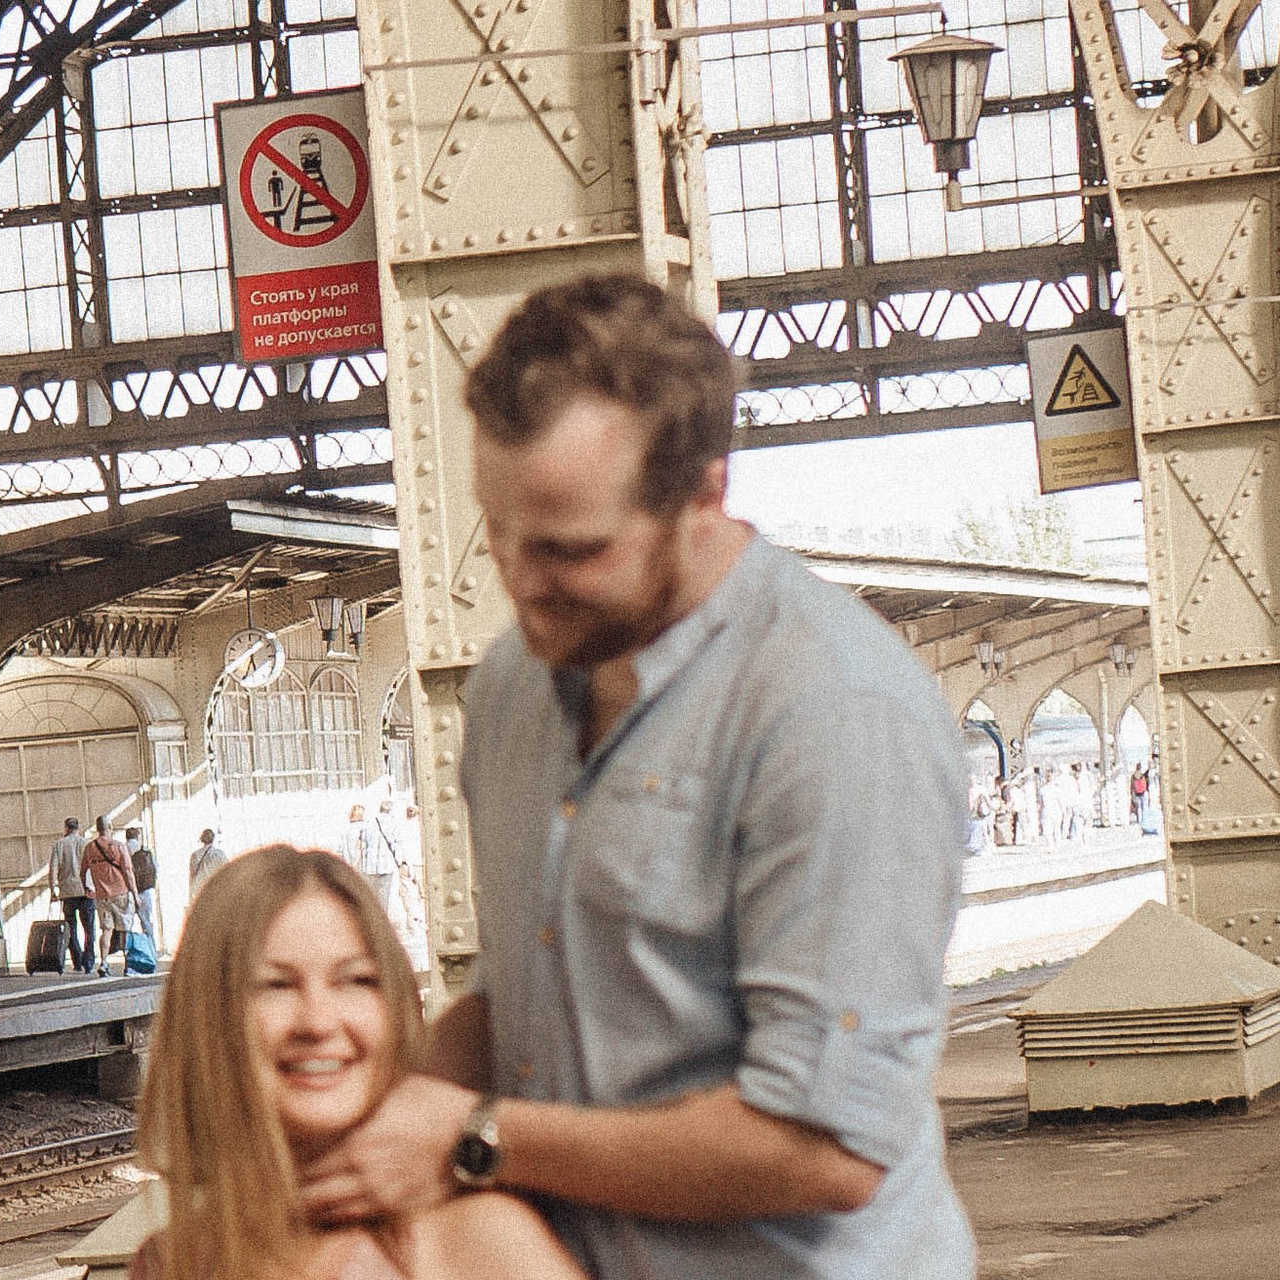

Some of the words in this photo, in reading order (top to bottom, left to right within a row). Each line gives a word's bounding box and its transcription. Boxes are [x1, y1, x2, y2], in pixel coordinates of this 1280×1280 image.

[250, 289, 305, 305] Стоять
[308, 287, 317, 303] у
[321, 282, 359, 299] края
[253, 305, 347, 326] платформы
[254, 334, 274, 347] не
[278, 322, 376, 347] допускается
